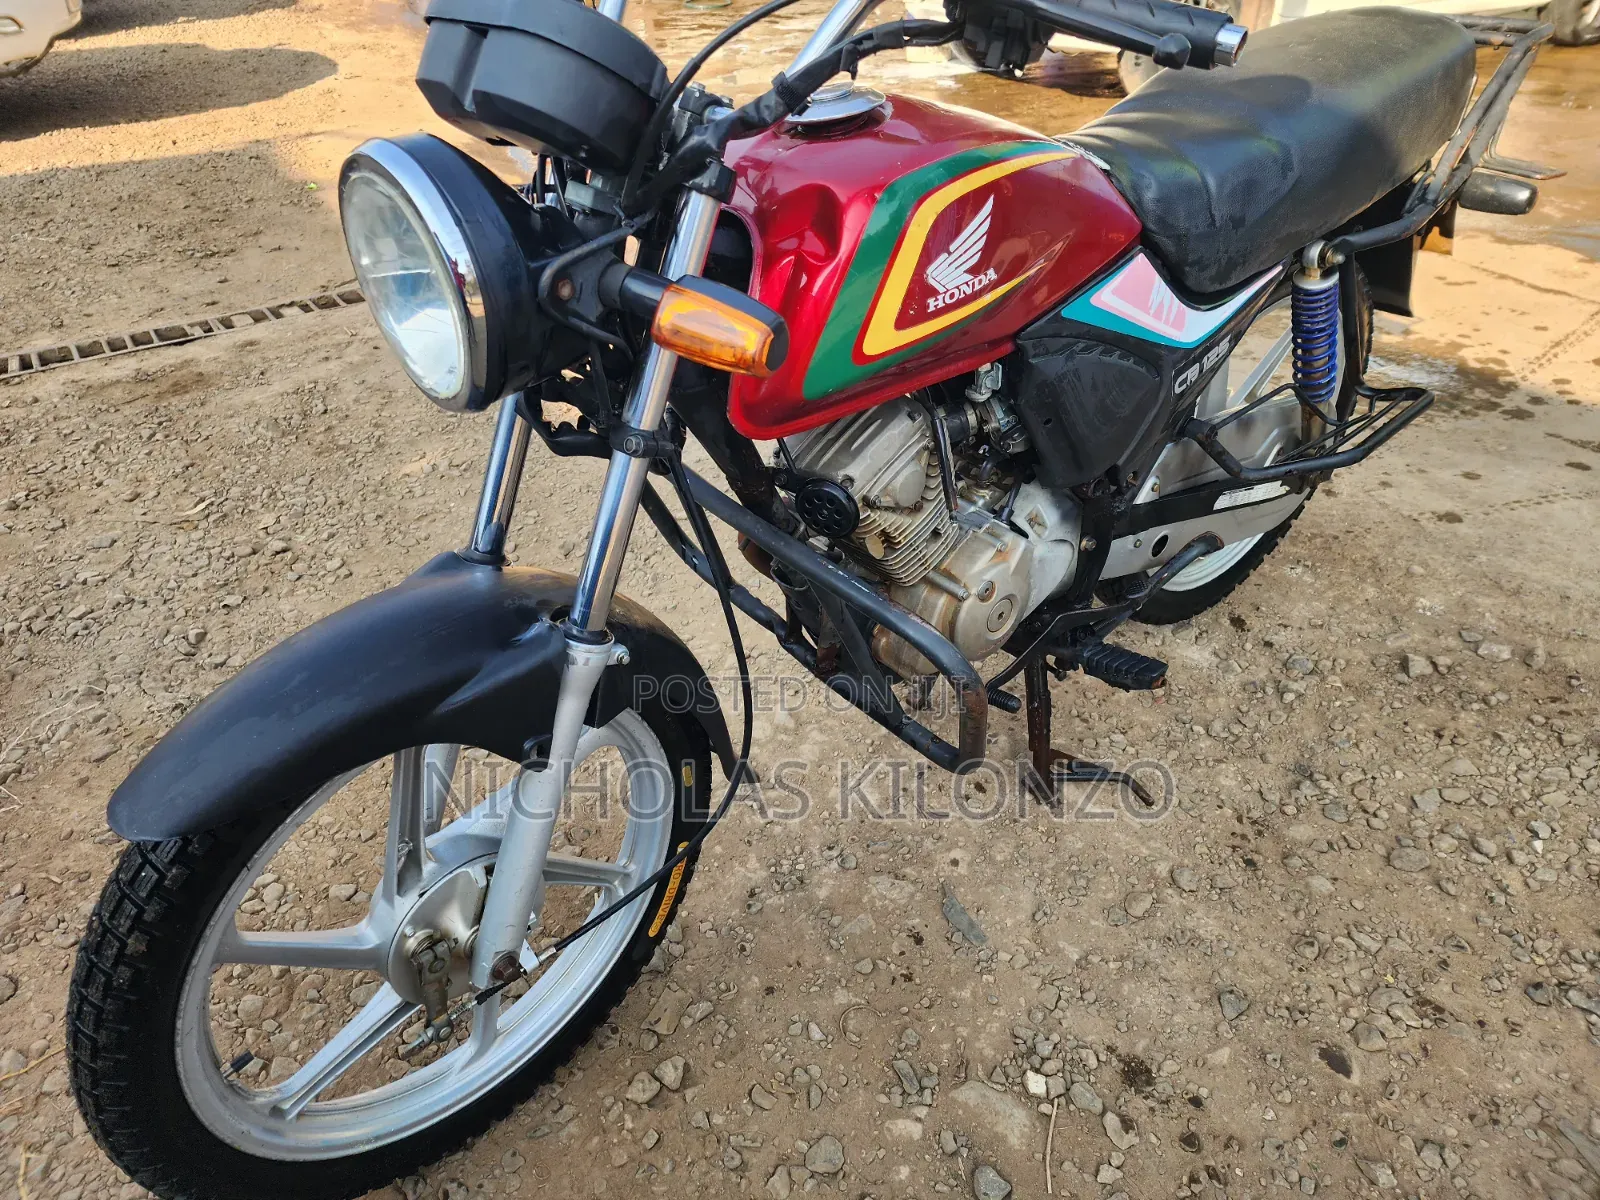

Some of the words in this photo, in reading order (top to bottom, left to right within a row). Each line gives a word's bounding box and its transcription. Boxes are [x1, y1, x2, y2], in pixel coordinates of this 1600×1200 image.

[927, 267, 998, 313] HONDA
[1174, 362, 1200, 394] CB
[1201, 333, 1232, 373] 125
[657, 859, 686, 922] RO-DRIVE
